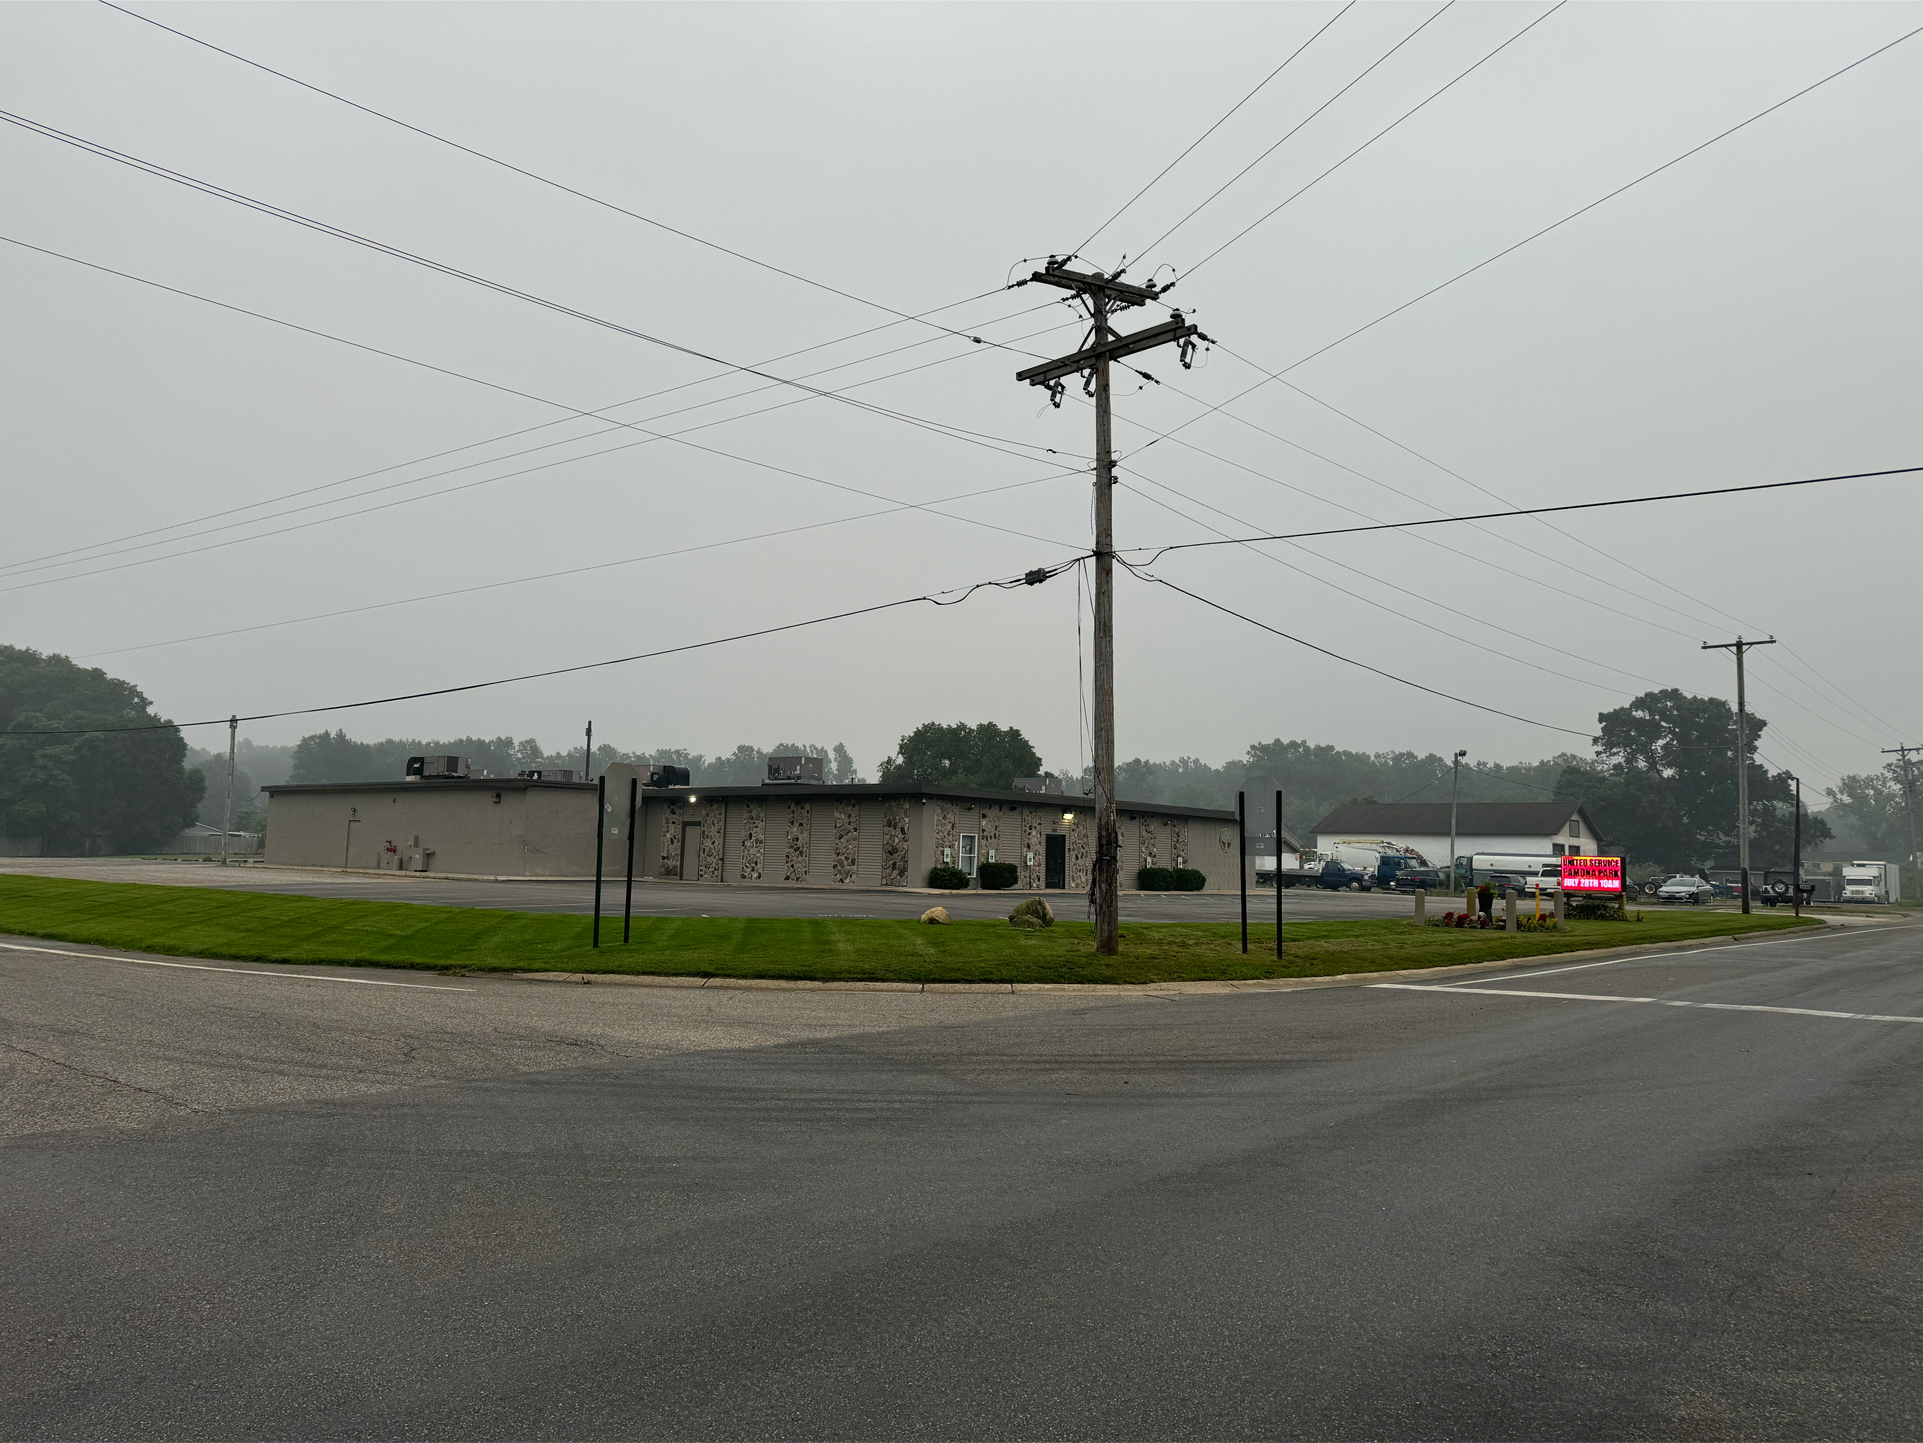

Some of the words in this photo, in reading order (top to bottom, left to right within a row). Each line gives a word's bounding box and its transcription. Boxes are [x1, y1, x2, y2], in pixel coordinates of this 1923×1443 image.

[1563, 859, 1588, 867] UNITED
[1589, 859, 1619, 867] SERVICE
[1598, 869, 1619, 878] PARK
[1564, 879, 1579, 887] JULY
[1580, 879, 1599, 887] 28TH
[1600, 880, 1620, 888] 10AM
